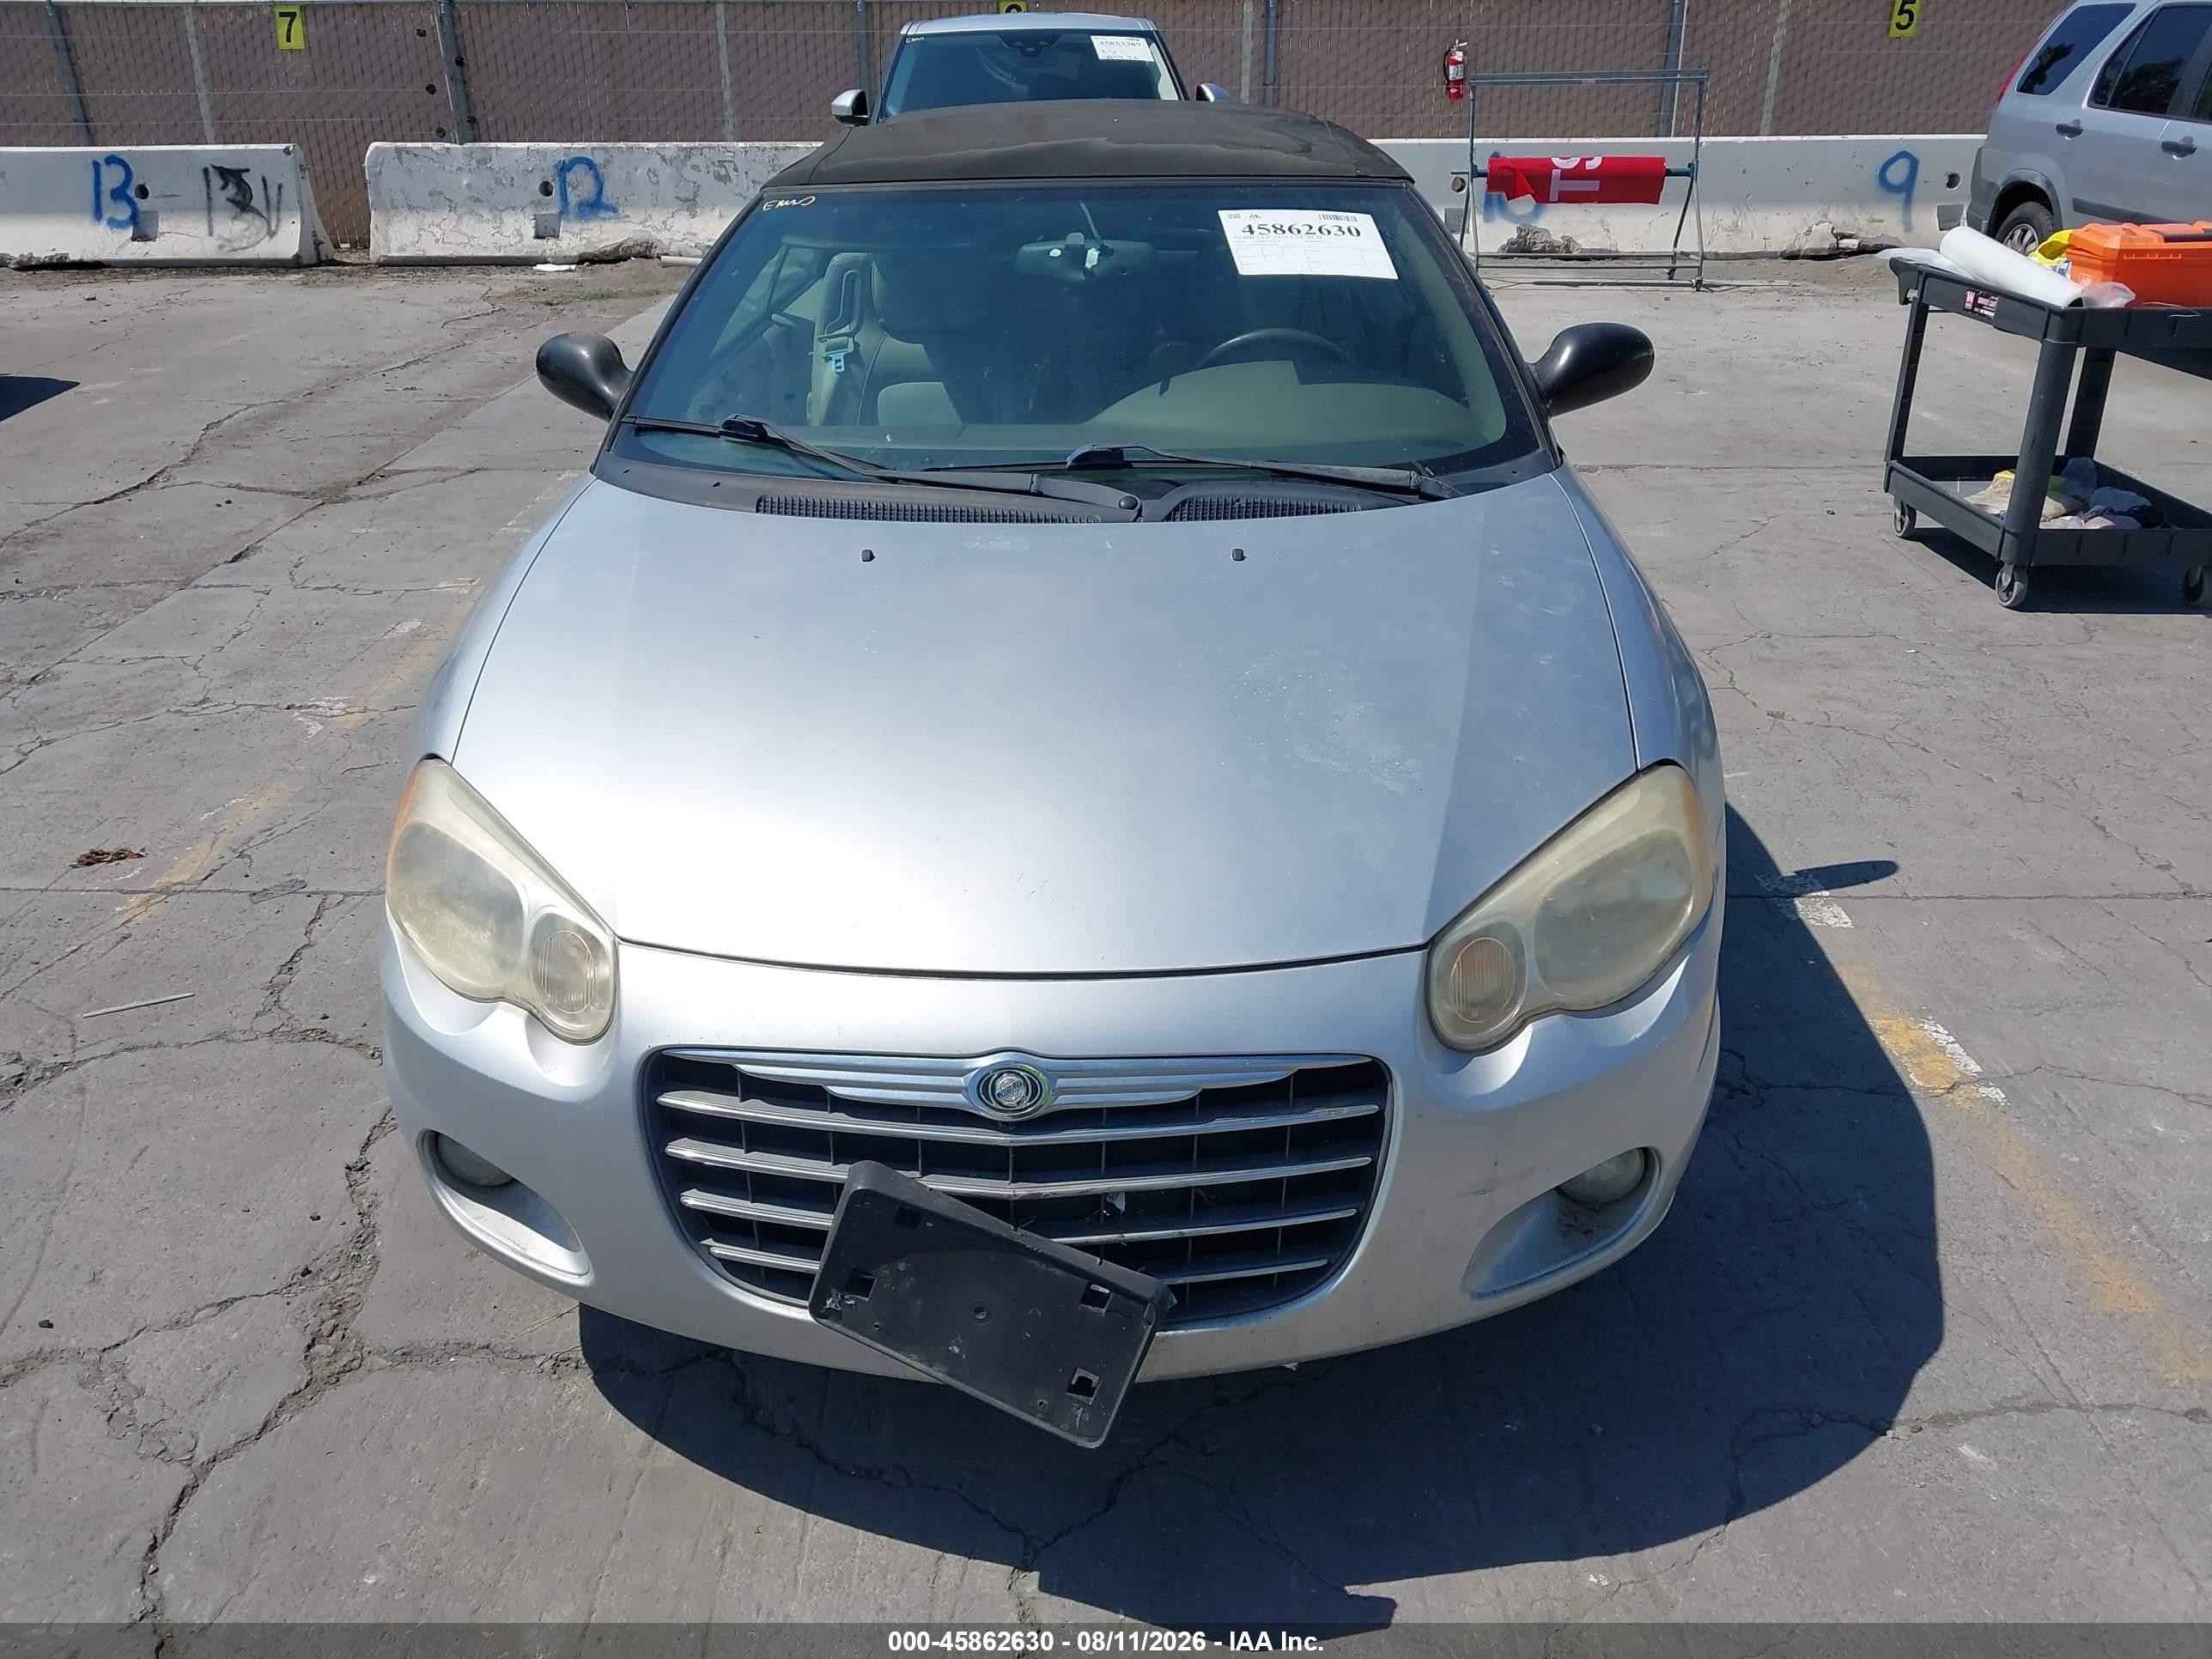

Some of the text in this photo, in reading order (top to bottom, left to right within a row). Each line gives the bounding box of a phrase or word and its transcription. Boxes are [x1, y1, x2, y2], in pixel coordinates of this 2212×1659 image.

[278, 12, 297, 43] 7
[1895, 0, 1917, 30] 5
[92, 154, 139, 229] 13
[1878, 150, 1920, 234] 9
[1242, 222, 1361, 238] 45862630
